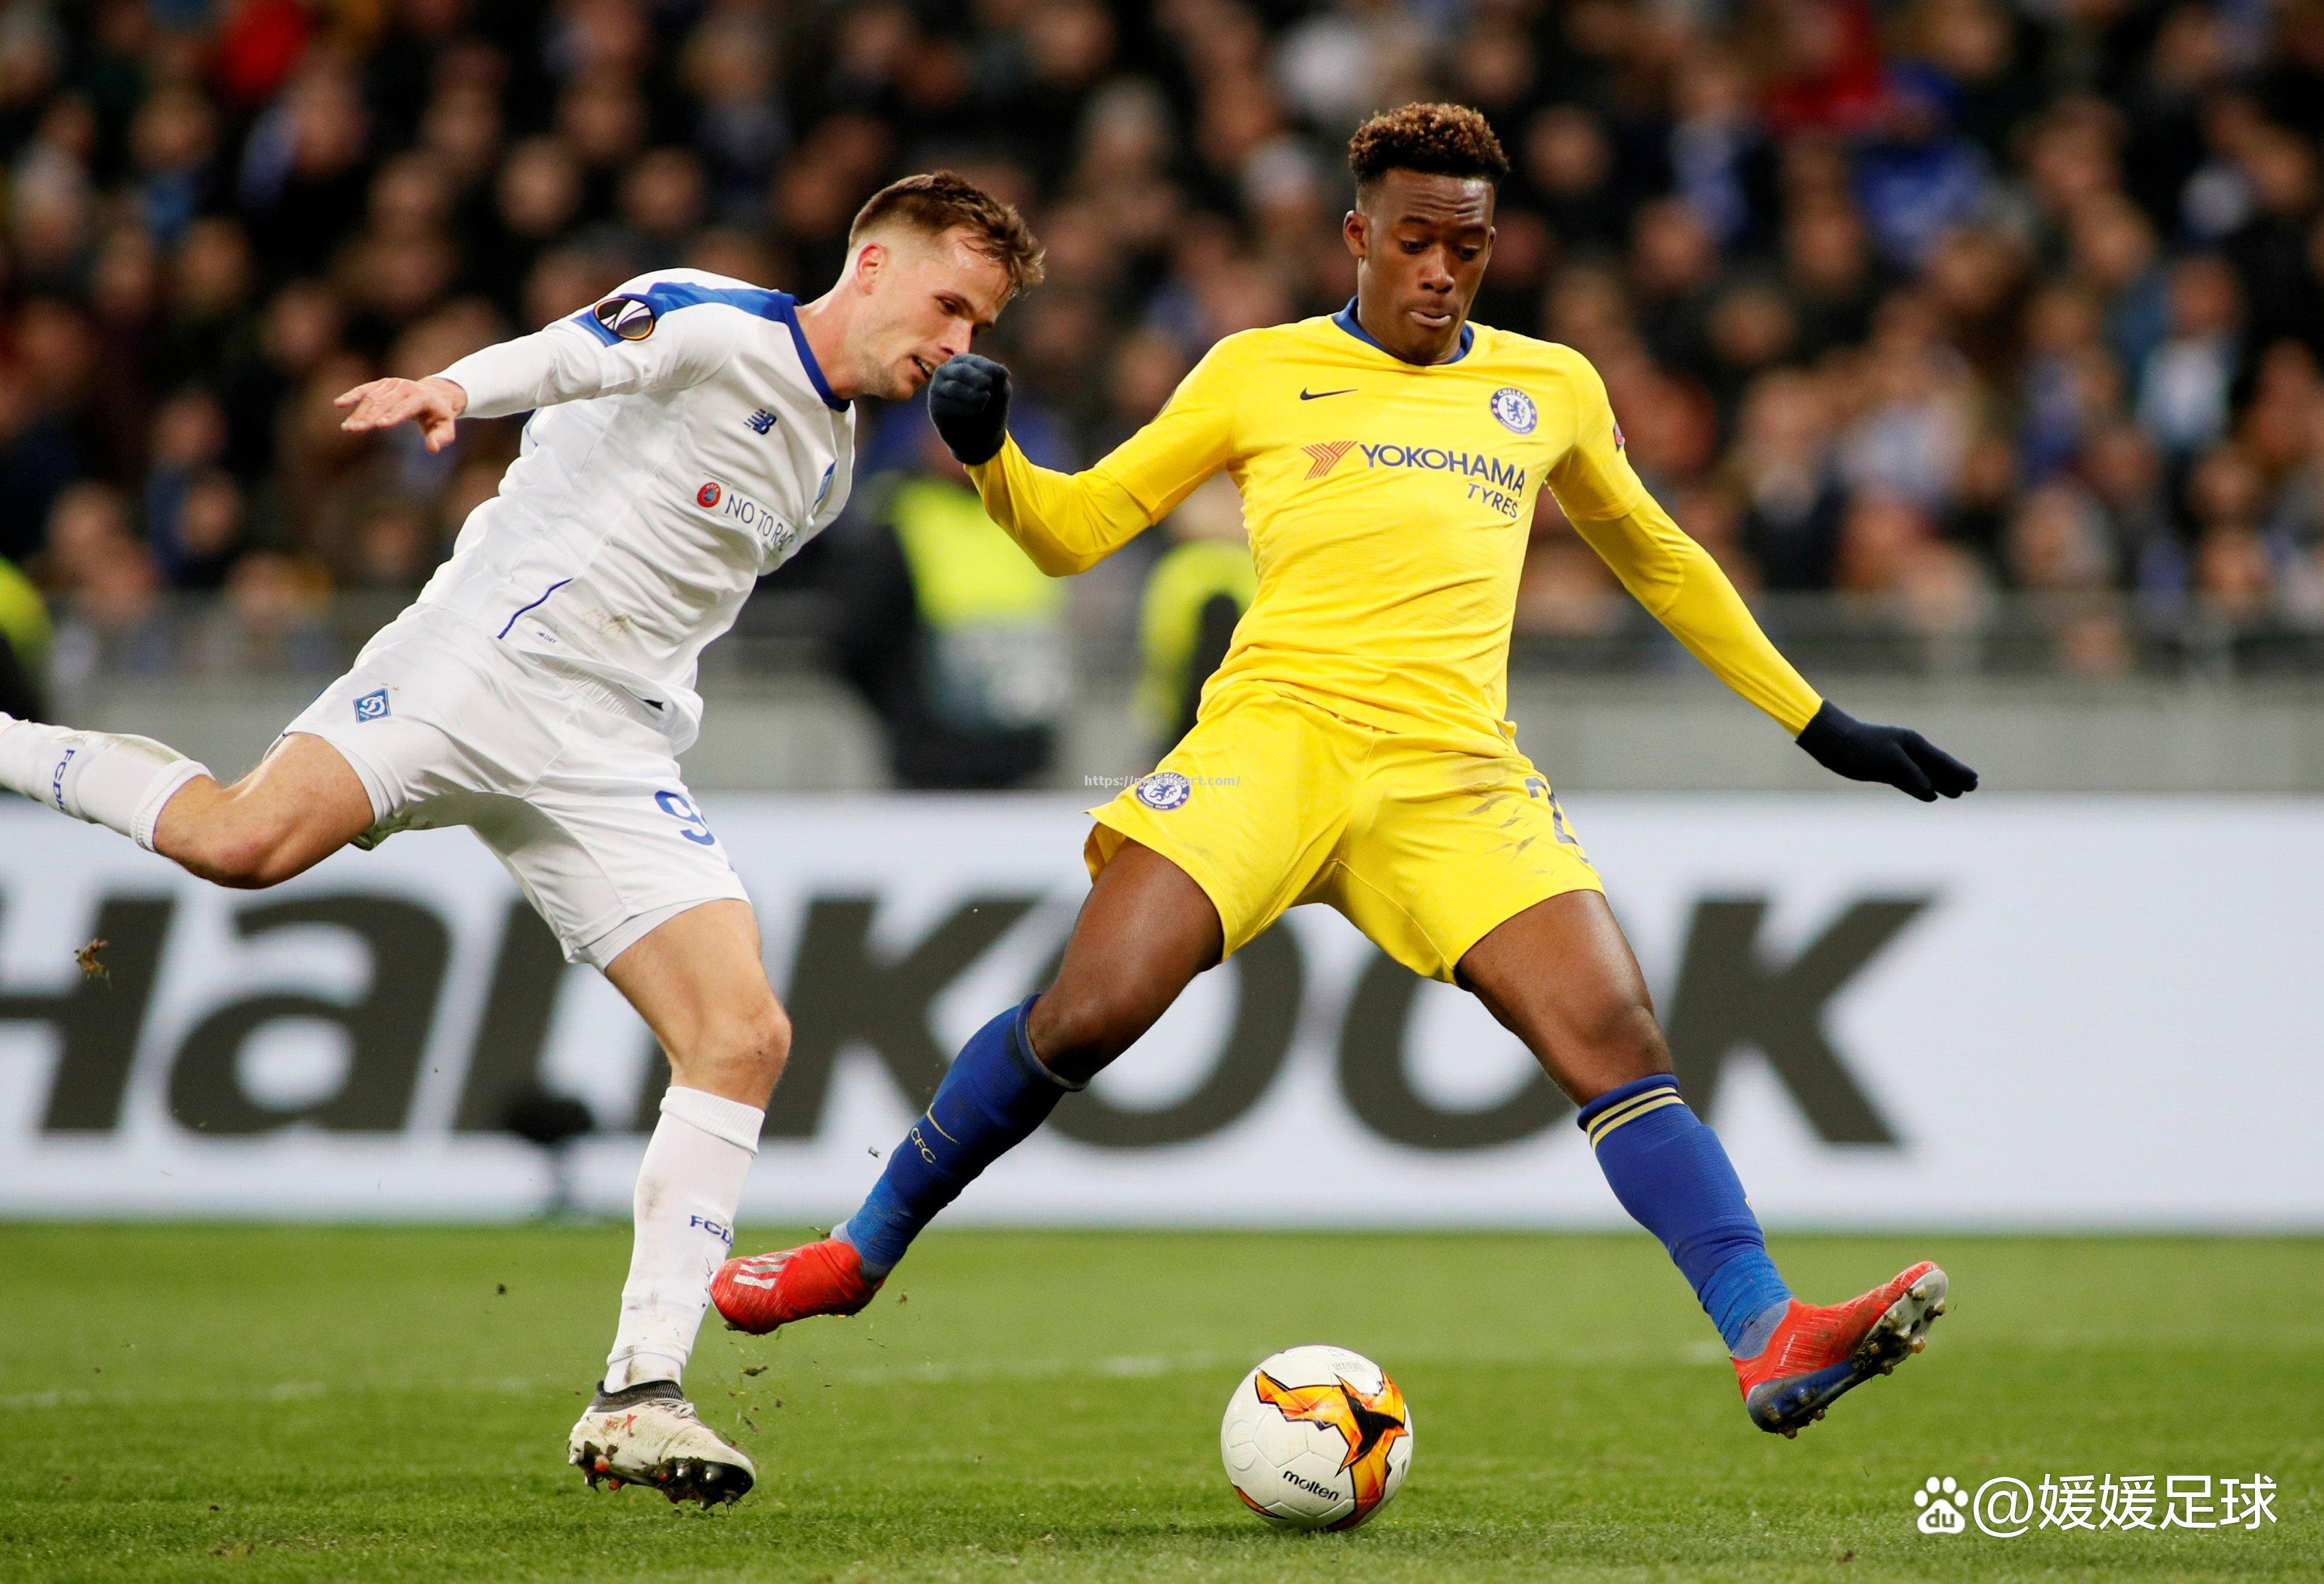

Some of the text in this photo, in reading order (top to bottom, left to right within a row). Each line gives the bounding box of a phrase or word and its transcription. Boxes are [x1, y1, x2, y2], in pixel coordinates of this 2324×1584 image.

[1497, 388, 1530, 404] CHELSEA
[1360, 443, 1526, 497] YOKOHAMA
[725, 494, 755, 524] NO
[757, 509, 774, 537] TO
[1467, 483, 1518, 518] TYRES
[910, 1127, 936, 1164] CFC
[691, 1214, 733, 1247] FCD
[1282, 1469, 1340, 1502] molten
